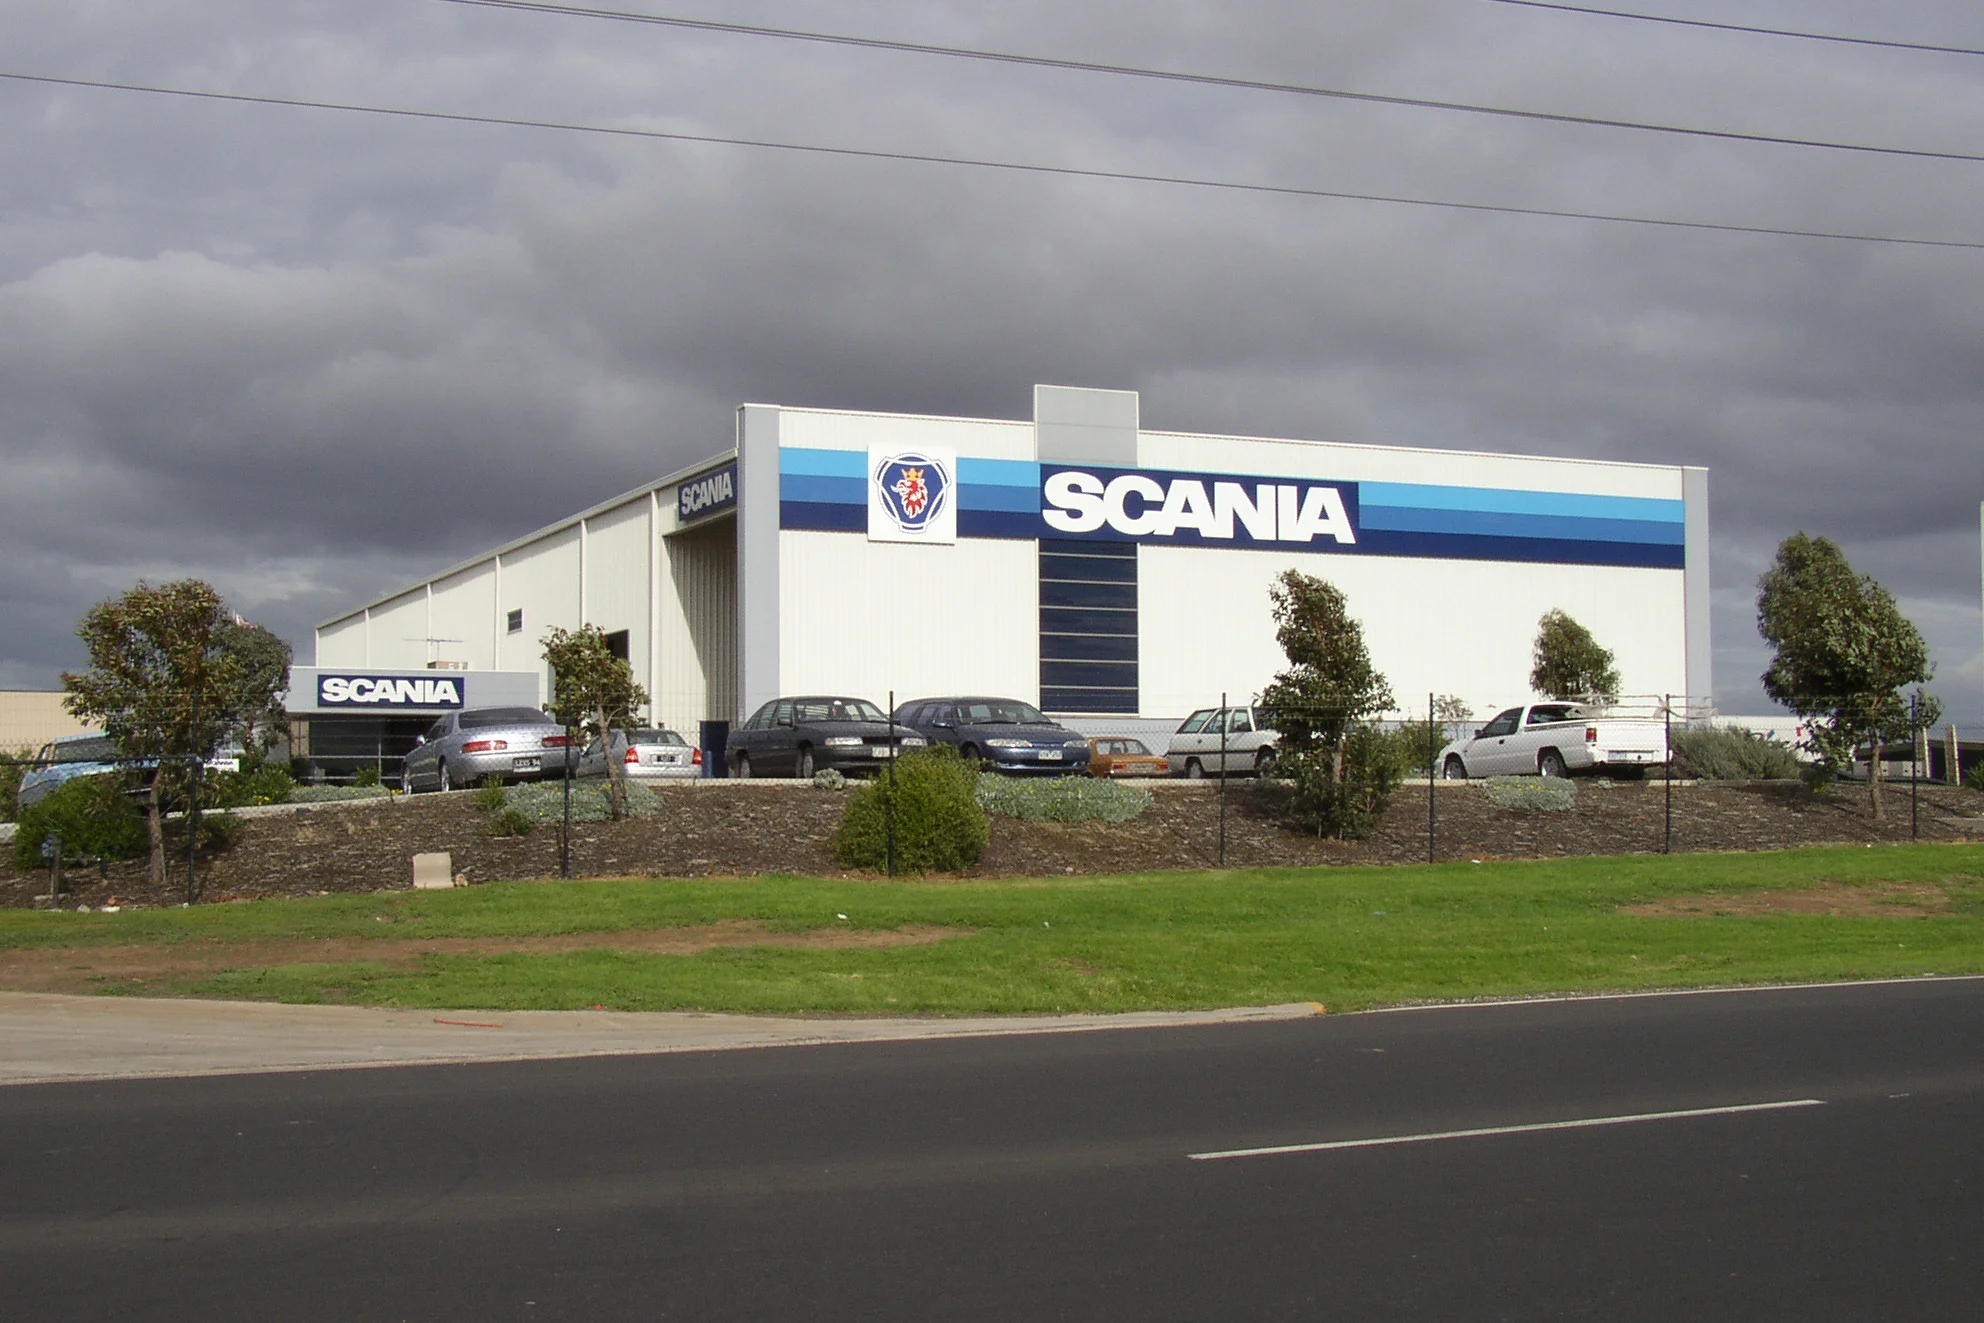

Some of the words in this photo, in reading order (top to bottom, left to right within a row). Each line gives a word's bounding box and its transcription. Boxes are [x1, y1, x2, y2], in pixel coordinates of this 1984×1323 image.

[681, 471, 733, 515] SCANIA
[1042, 471, 1356, 544] SCANIA
[321, 677, 461, 704] SCANIA
